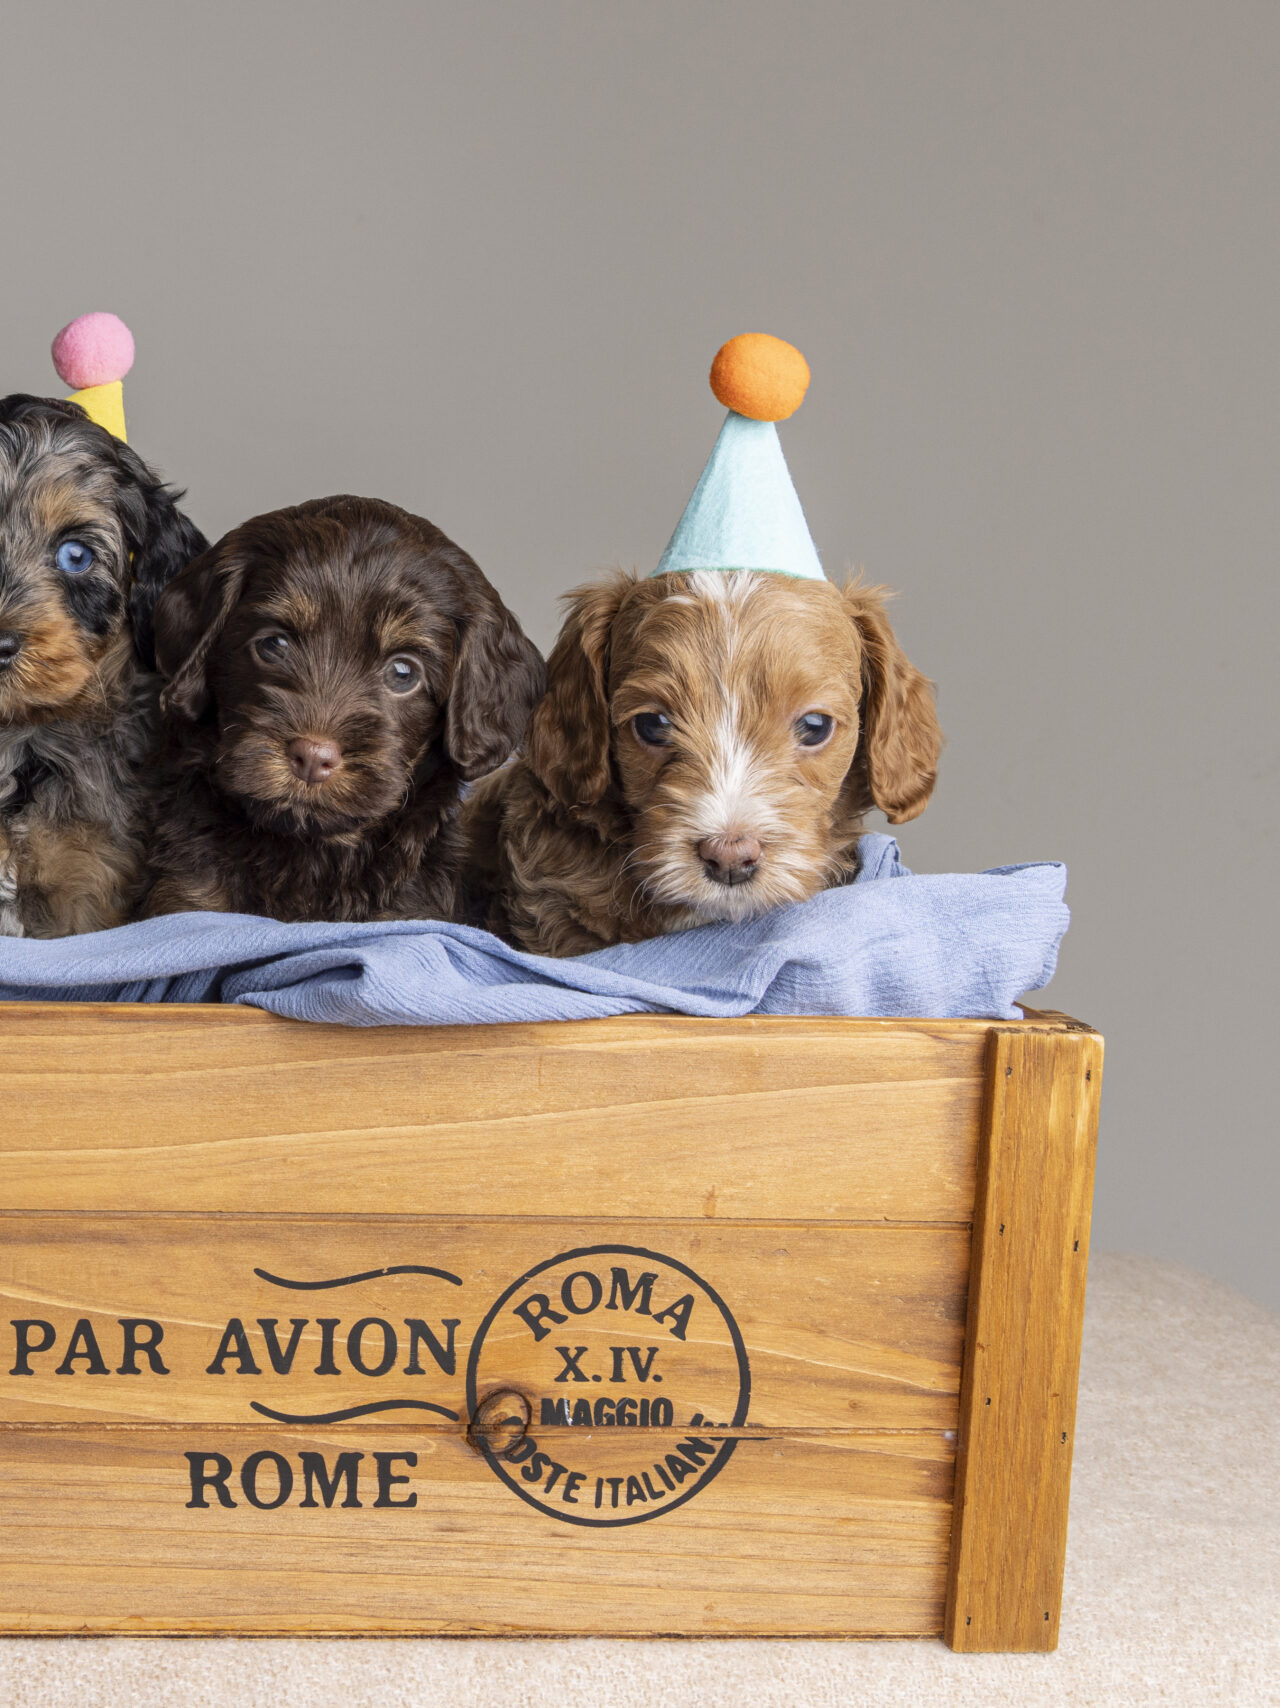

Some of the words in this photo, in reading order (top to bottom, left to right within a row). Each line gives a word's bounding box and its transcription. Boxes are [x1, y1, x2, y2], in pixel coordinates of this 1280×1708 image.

[513, 1267, 695, 1342] ROMA
[9, 1318, 170, 1376] PAR
[206, 1317, 461, 1377] AVION
[540, 1397, 674, 1427] MAGGIO
[183, 1450, 418, 1510] ROME
